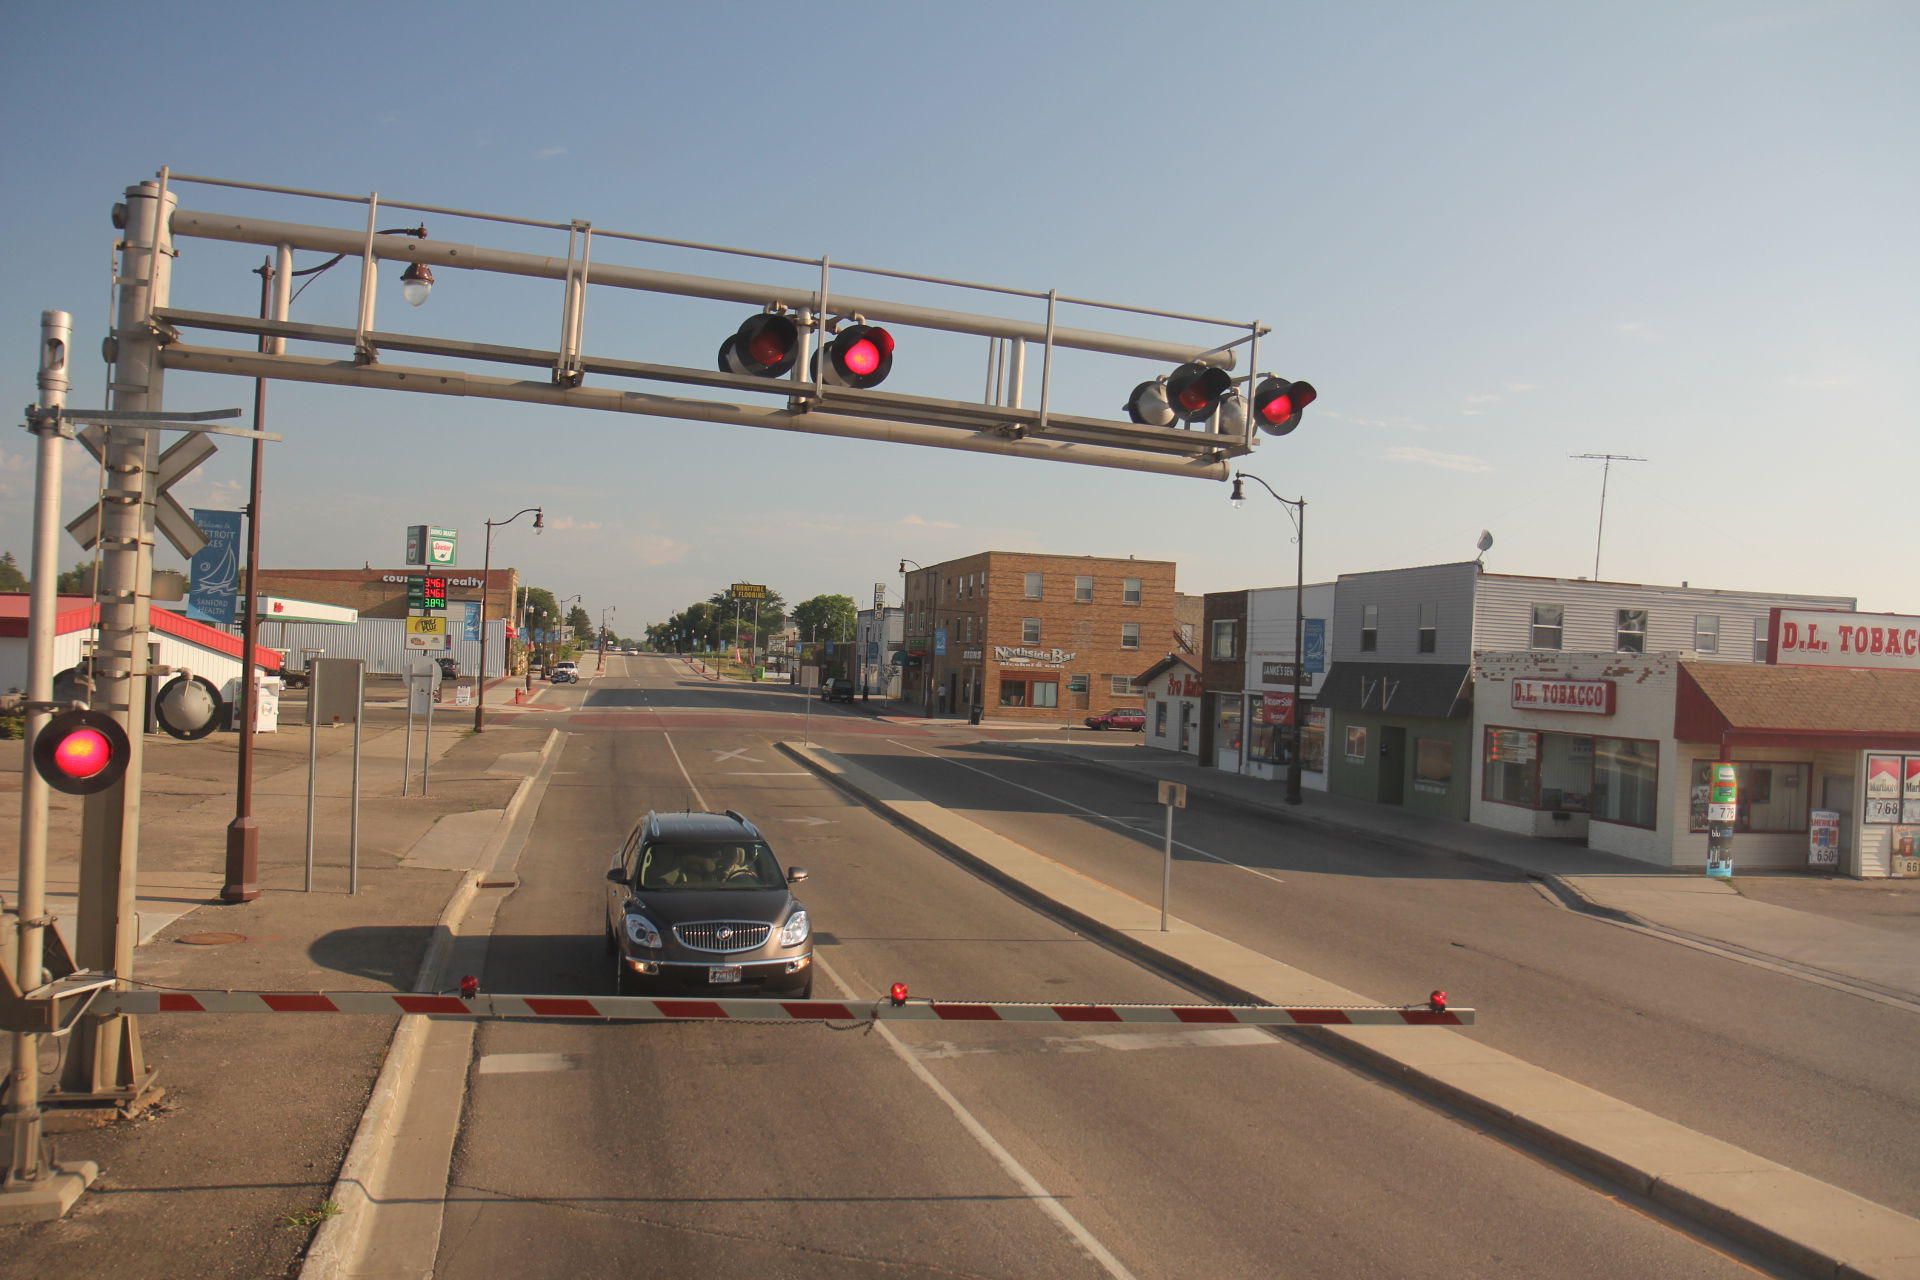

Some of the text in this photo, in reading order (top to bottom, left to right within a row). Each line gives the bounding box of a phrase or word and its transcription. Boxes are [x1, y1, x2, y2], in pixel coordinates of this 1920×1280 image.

[447, 576, 485, 589] realty
[733, 584, 764, 593] FURNITURE
[738, 591, 766, 599] FLOORING
[196, 597, 229, 608] SANFORD
[197, 605, 226, 615] HEALTH
[1783, 622, 1829, 653] D.L.
[992, 645, 1077, 664] Northside Bar
[1514, 682, 1603, 707] D.L. TOBACCO
[1869, 779, 1897, 792] Marlboro
